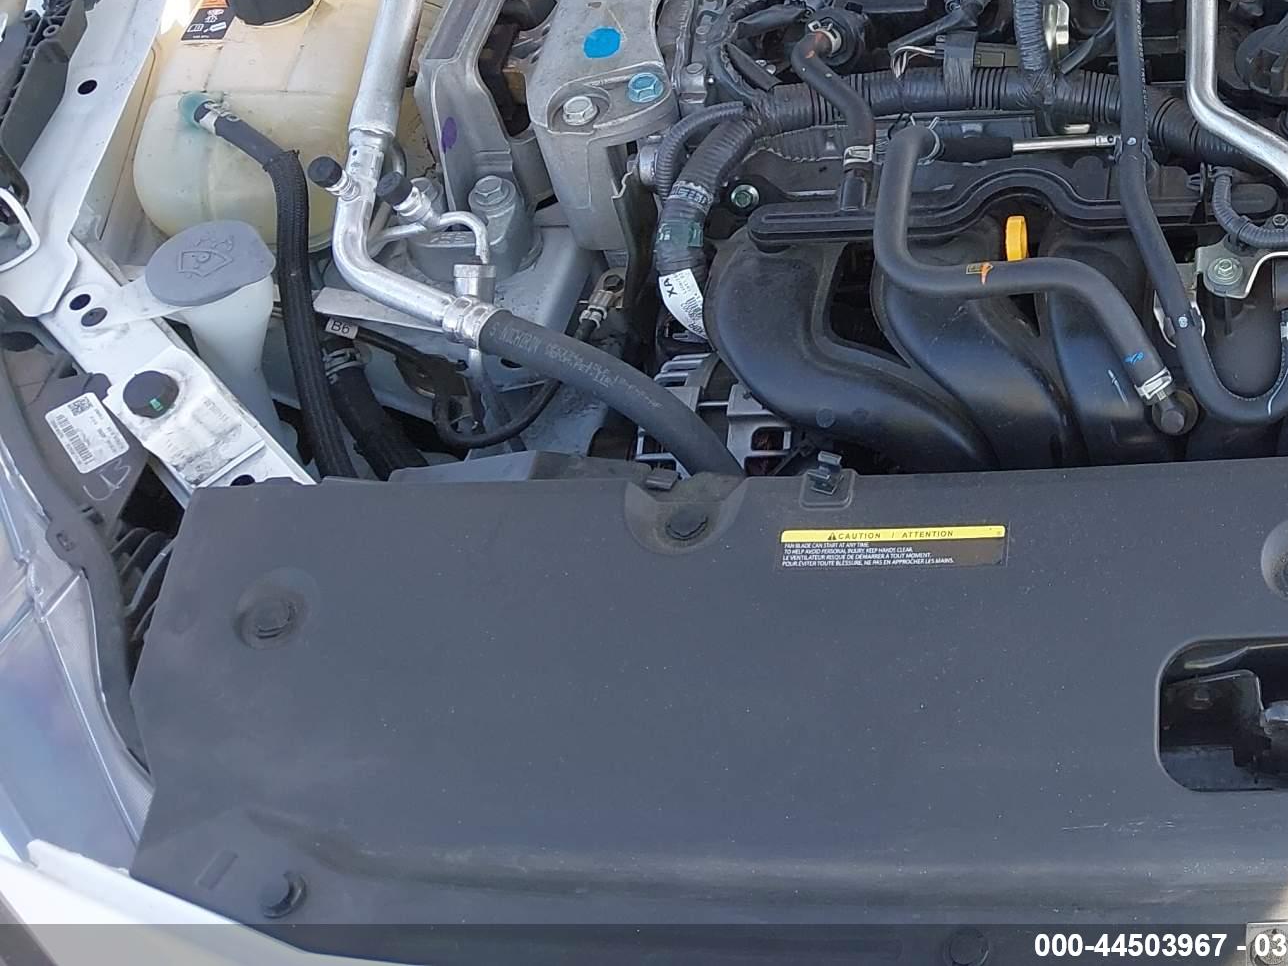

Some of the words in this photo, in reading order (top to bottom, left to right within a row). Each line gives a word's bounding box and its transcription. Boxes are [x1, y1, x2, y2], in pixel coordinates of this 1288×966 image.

[330, 319, 350, 333] B6
[838, 532, 881, 540] CAUTION
[902, 530, 954, 538] ATTENTION
